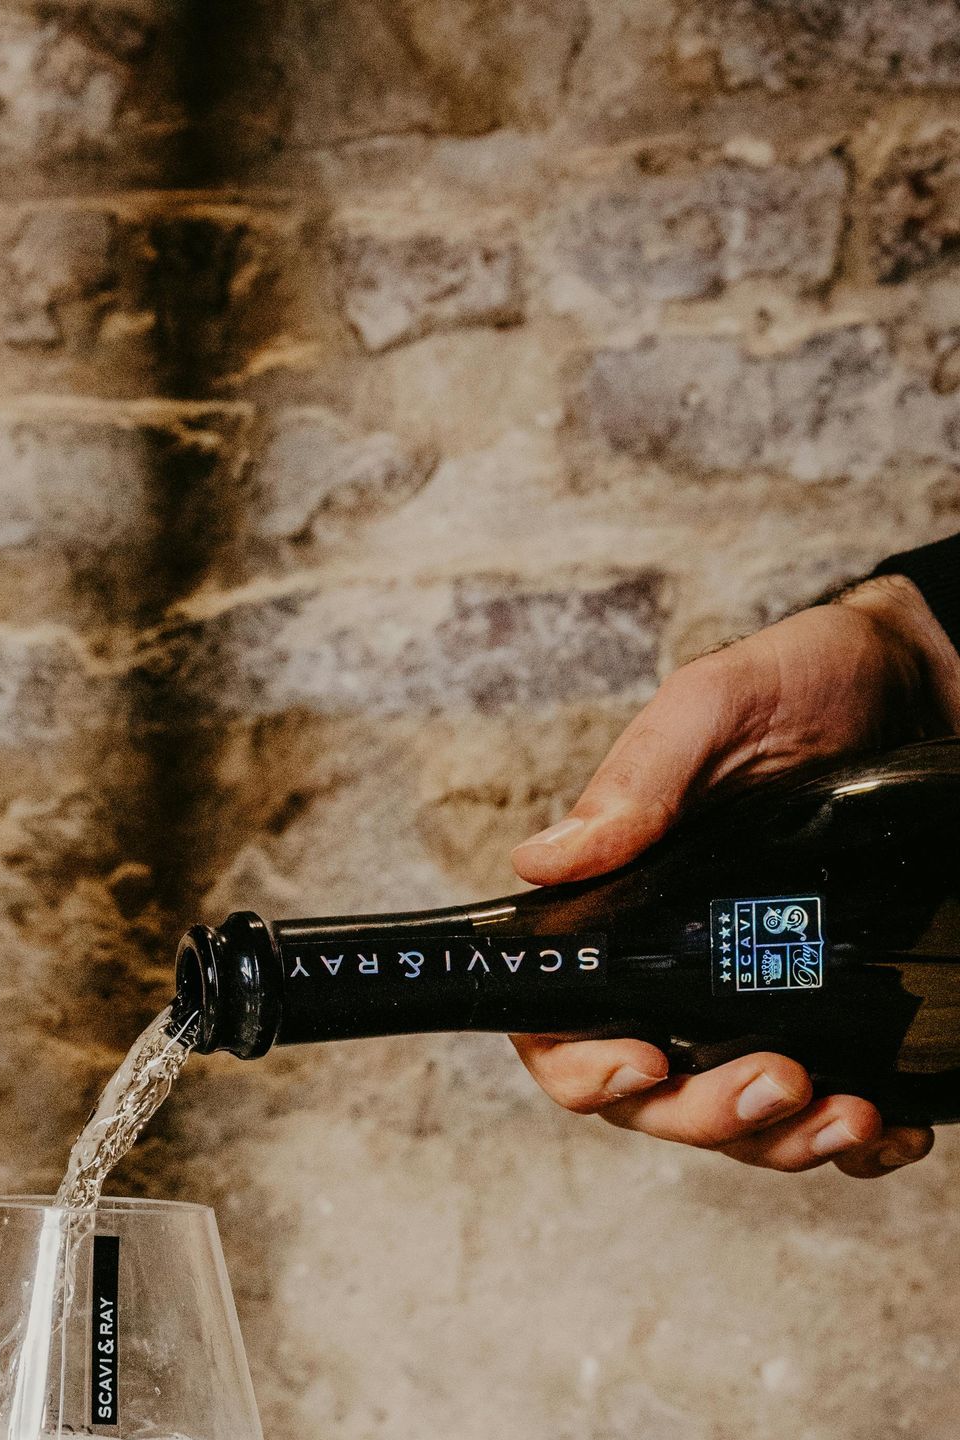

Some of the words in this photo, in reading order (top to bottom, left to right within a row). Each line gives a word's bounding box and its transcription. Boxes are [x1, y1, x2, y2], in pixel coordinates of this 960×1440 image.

[443, 947, 600, 973] SCAVI
[740, 908, 752, 983] SCAVI
[290, 953, 379, 978] RAY
[397, 950, 425, 978] &
[792, 944, 819, 987] Ray
[99, 1296, 114, 1335] RAY
[98, 1339, 114, 1355] &
[98, 1358, 113, 1419] SCAVI
